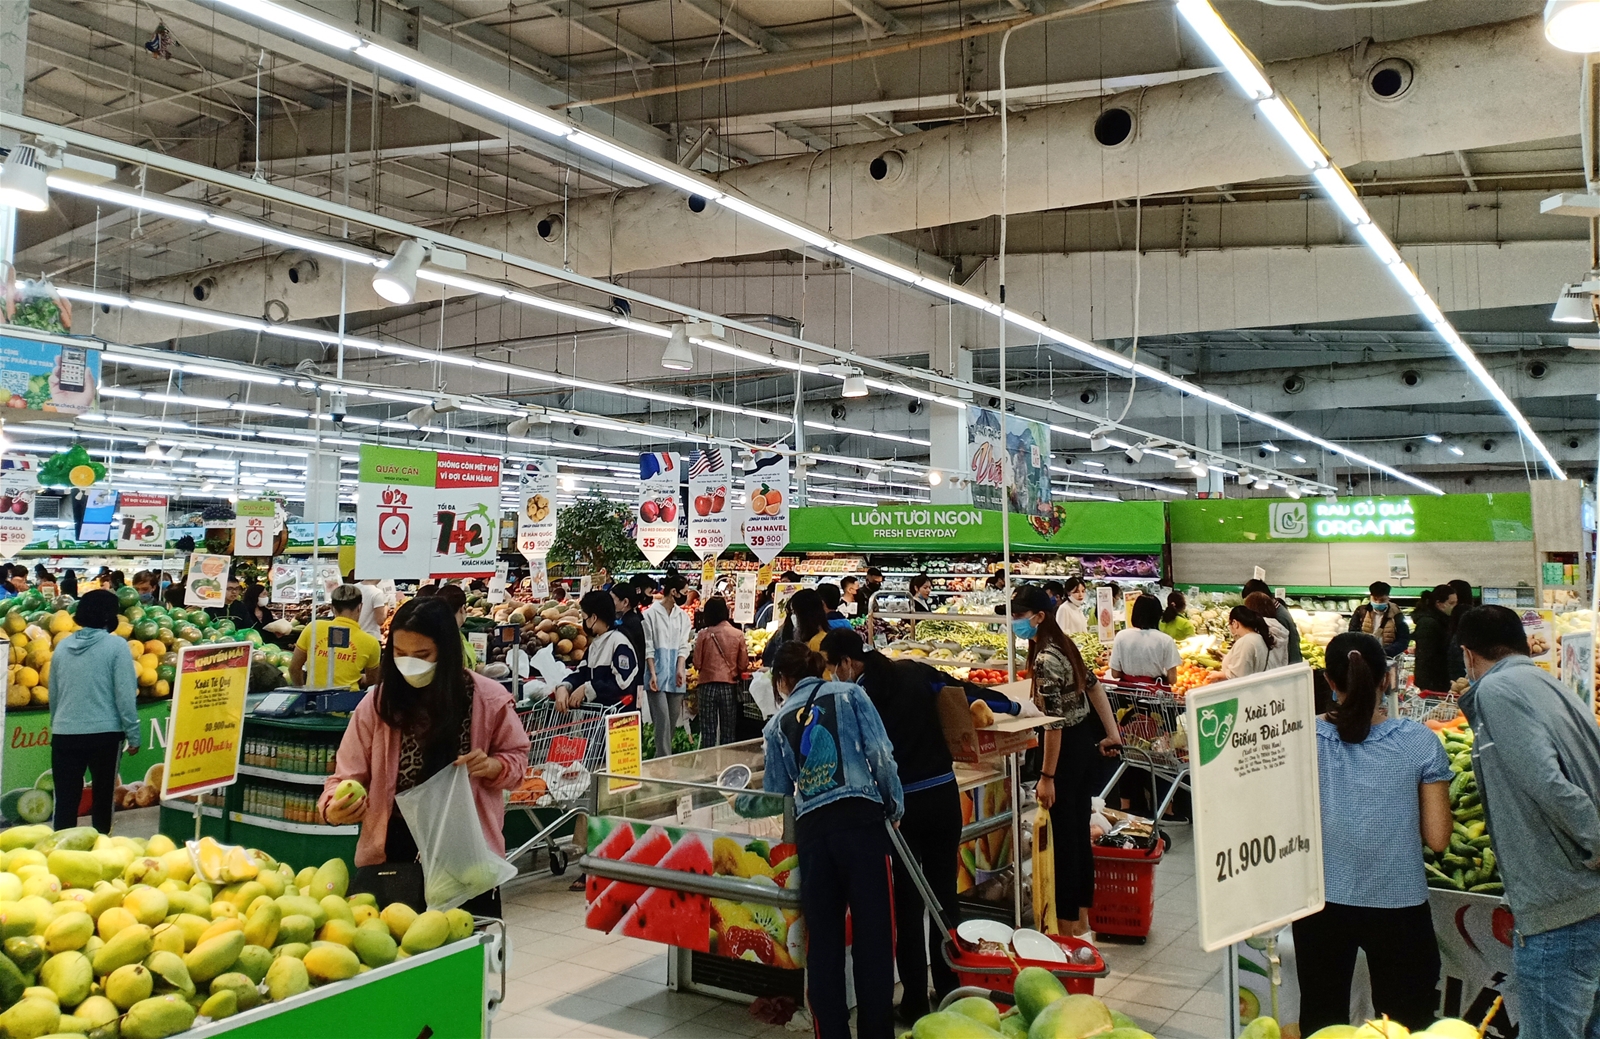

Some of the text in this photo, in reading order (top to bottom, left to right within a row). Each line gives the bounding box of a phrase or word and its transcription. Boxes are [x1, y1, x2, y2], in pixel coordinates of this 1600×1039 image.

[401, 465, 419, 475] CÂN
[437, 460, 460, 469] KHÔNG
[460, 461, 474, 470] CÒN
[474, 462, 487, 472] MỆT
[440, 471, 493, 483] VÌ ĐỢI CÂN HÀNG
[1315, 499, 1414, 517] RAU CỦ QUẢ
[851, 509, 982, 525] LUÔN TƯƠI NGON
[873, 529, 957, 538] FRESH EVERYDAY
[1316, 519, 1415, 536] ORGANIC
[0, 533, 26, 542] 5.900
[194, 650, 228, 668] KHUYẾN
[1245, 699, 1286, 723] Xoài Dài
[11, 726, 52, 749] luô
[1231, 719, 1304, 748] Giống Đài Loan
[175, 737, 214, 760] 27.900
[1215, 835, 1277, 883] 21.900
